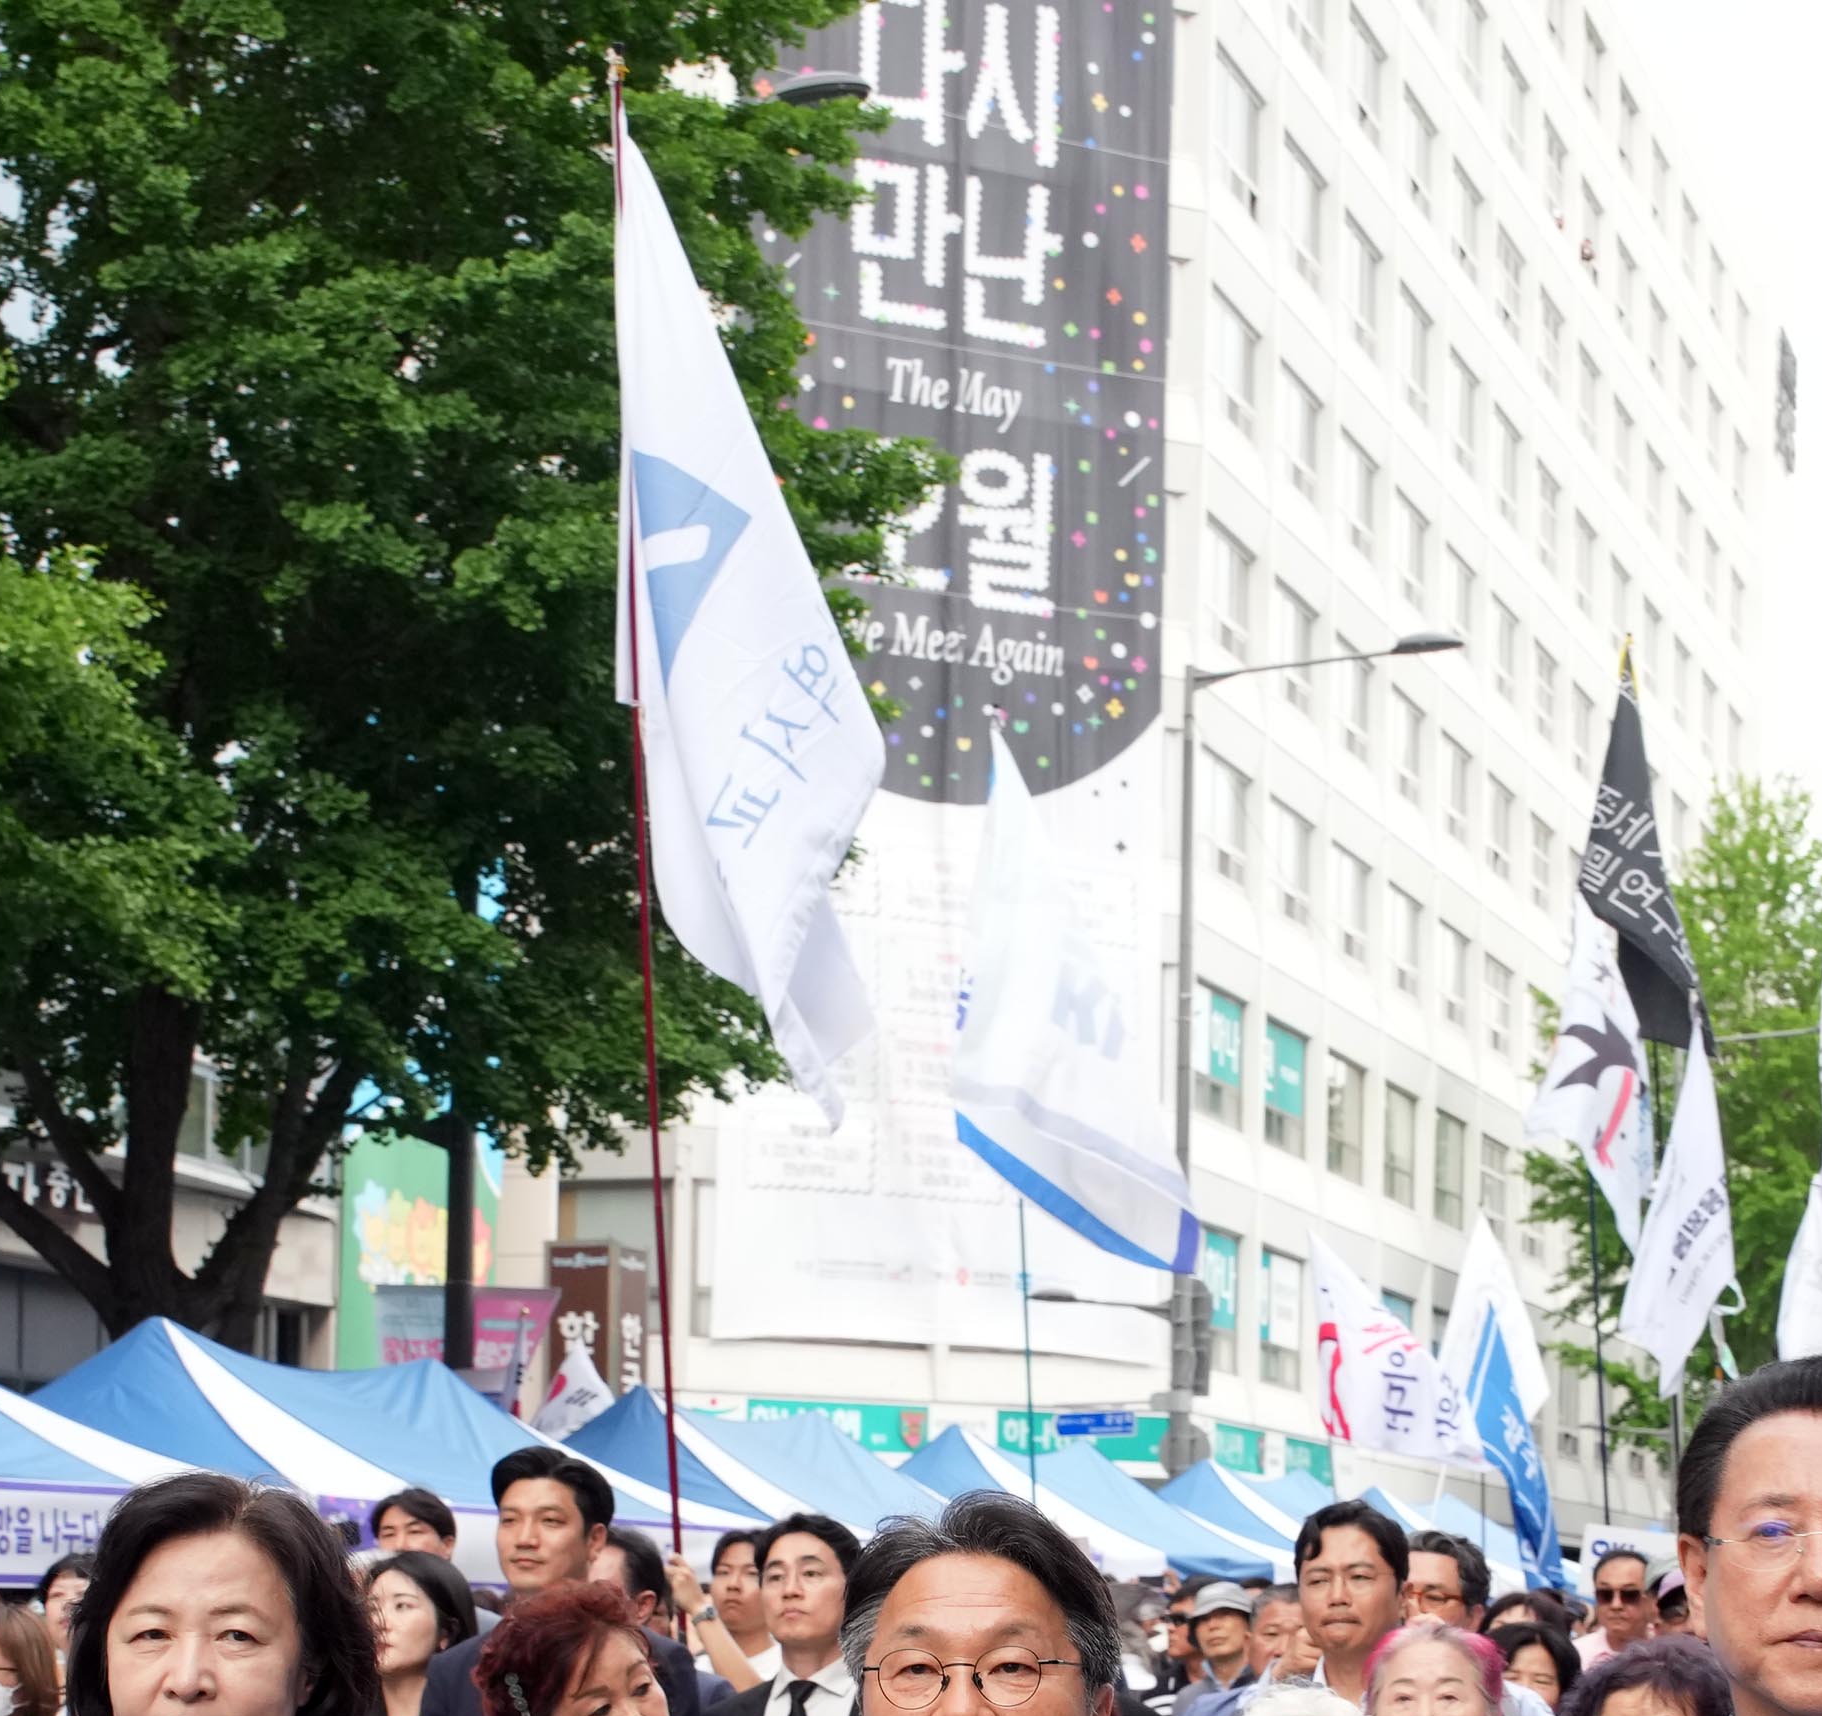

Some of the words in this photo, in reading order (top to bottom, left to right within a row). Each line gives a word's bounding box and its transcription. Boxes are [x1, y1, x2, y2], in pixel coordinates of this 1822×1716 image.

[852, 156, 1062, 350] 만난
[886, 357, 950, 410] The
[955, 368, 1022, 434] May
[969, 624, 1065, 686] Again
